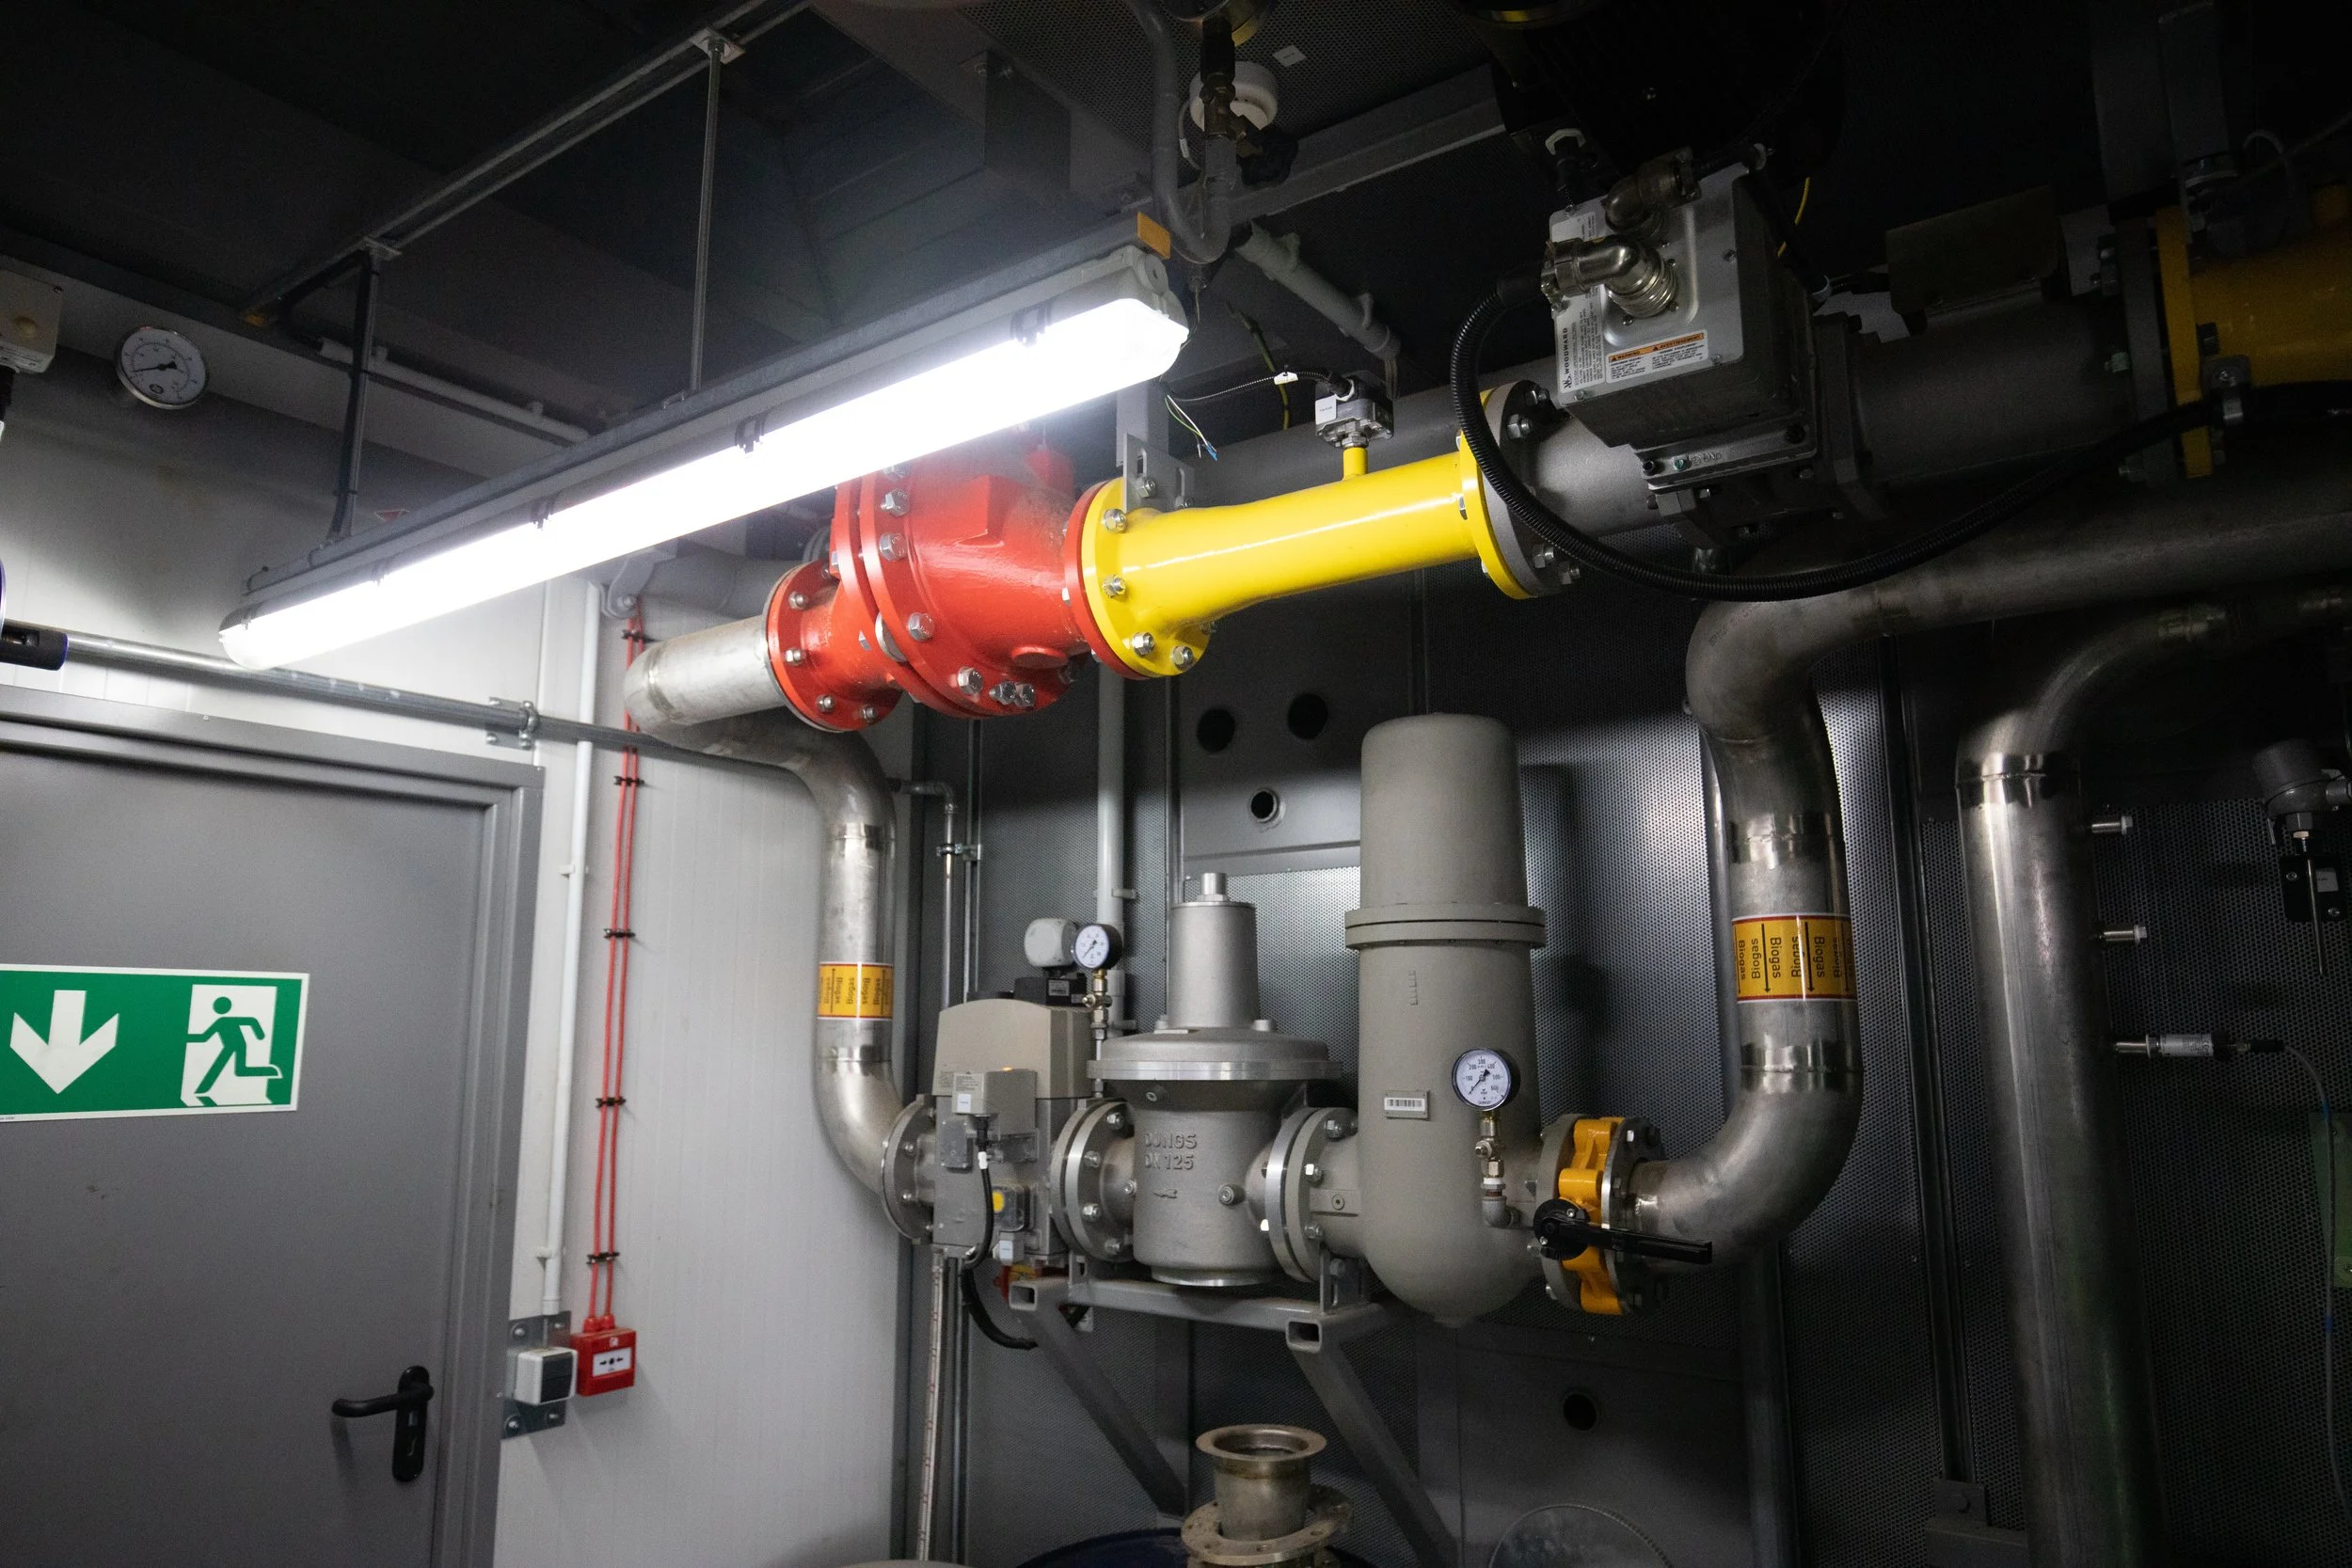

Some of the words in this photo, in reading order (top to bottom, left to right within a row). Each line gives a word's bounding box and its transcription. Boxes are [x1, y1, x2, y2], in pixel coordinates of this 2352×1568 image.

[1752, 938, 1761, 979] Biogas
[1769, 937, 1782, 978] Biogas
[1814, 936, 1825, 978] Biogas
[834, 977, 843, 1004] Biogas
[846, 977, 856, 1005] Biogas
[861, 977, 870, 1005] Biogas
[1144, 1132, 1198, 1149] DUNGS
[1165, 1153, 1194, 1170] 125
